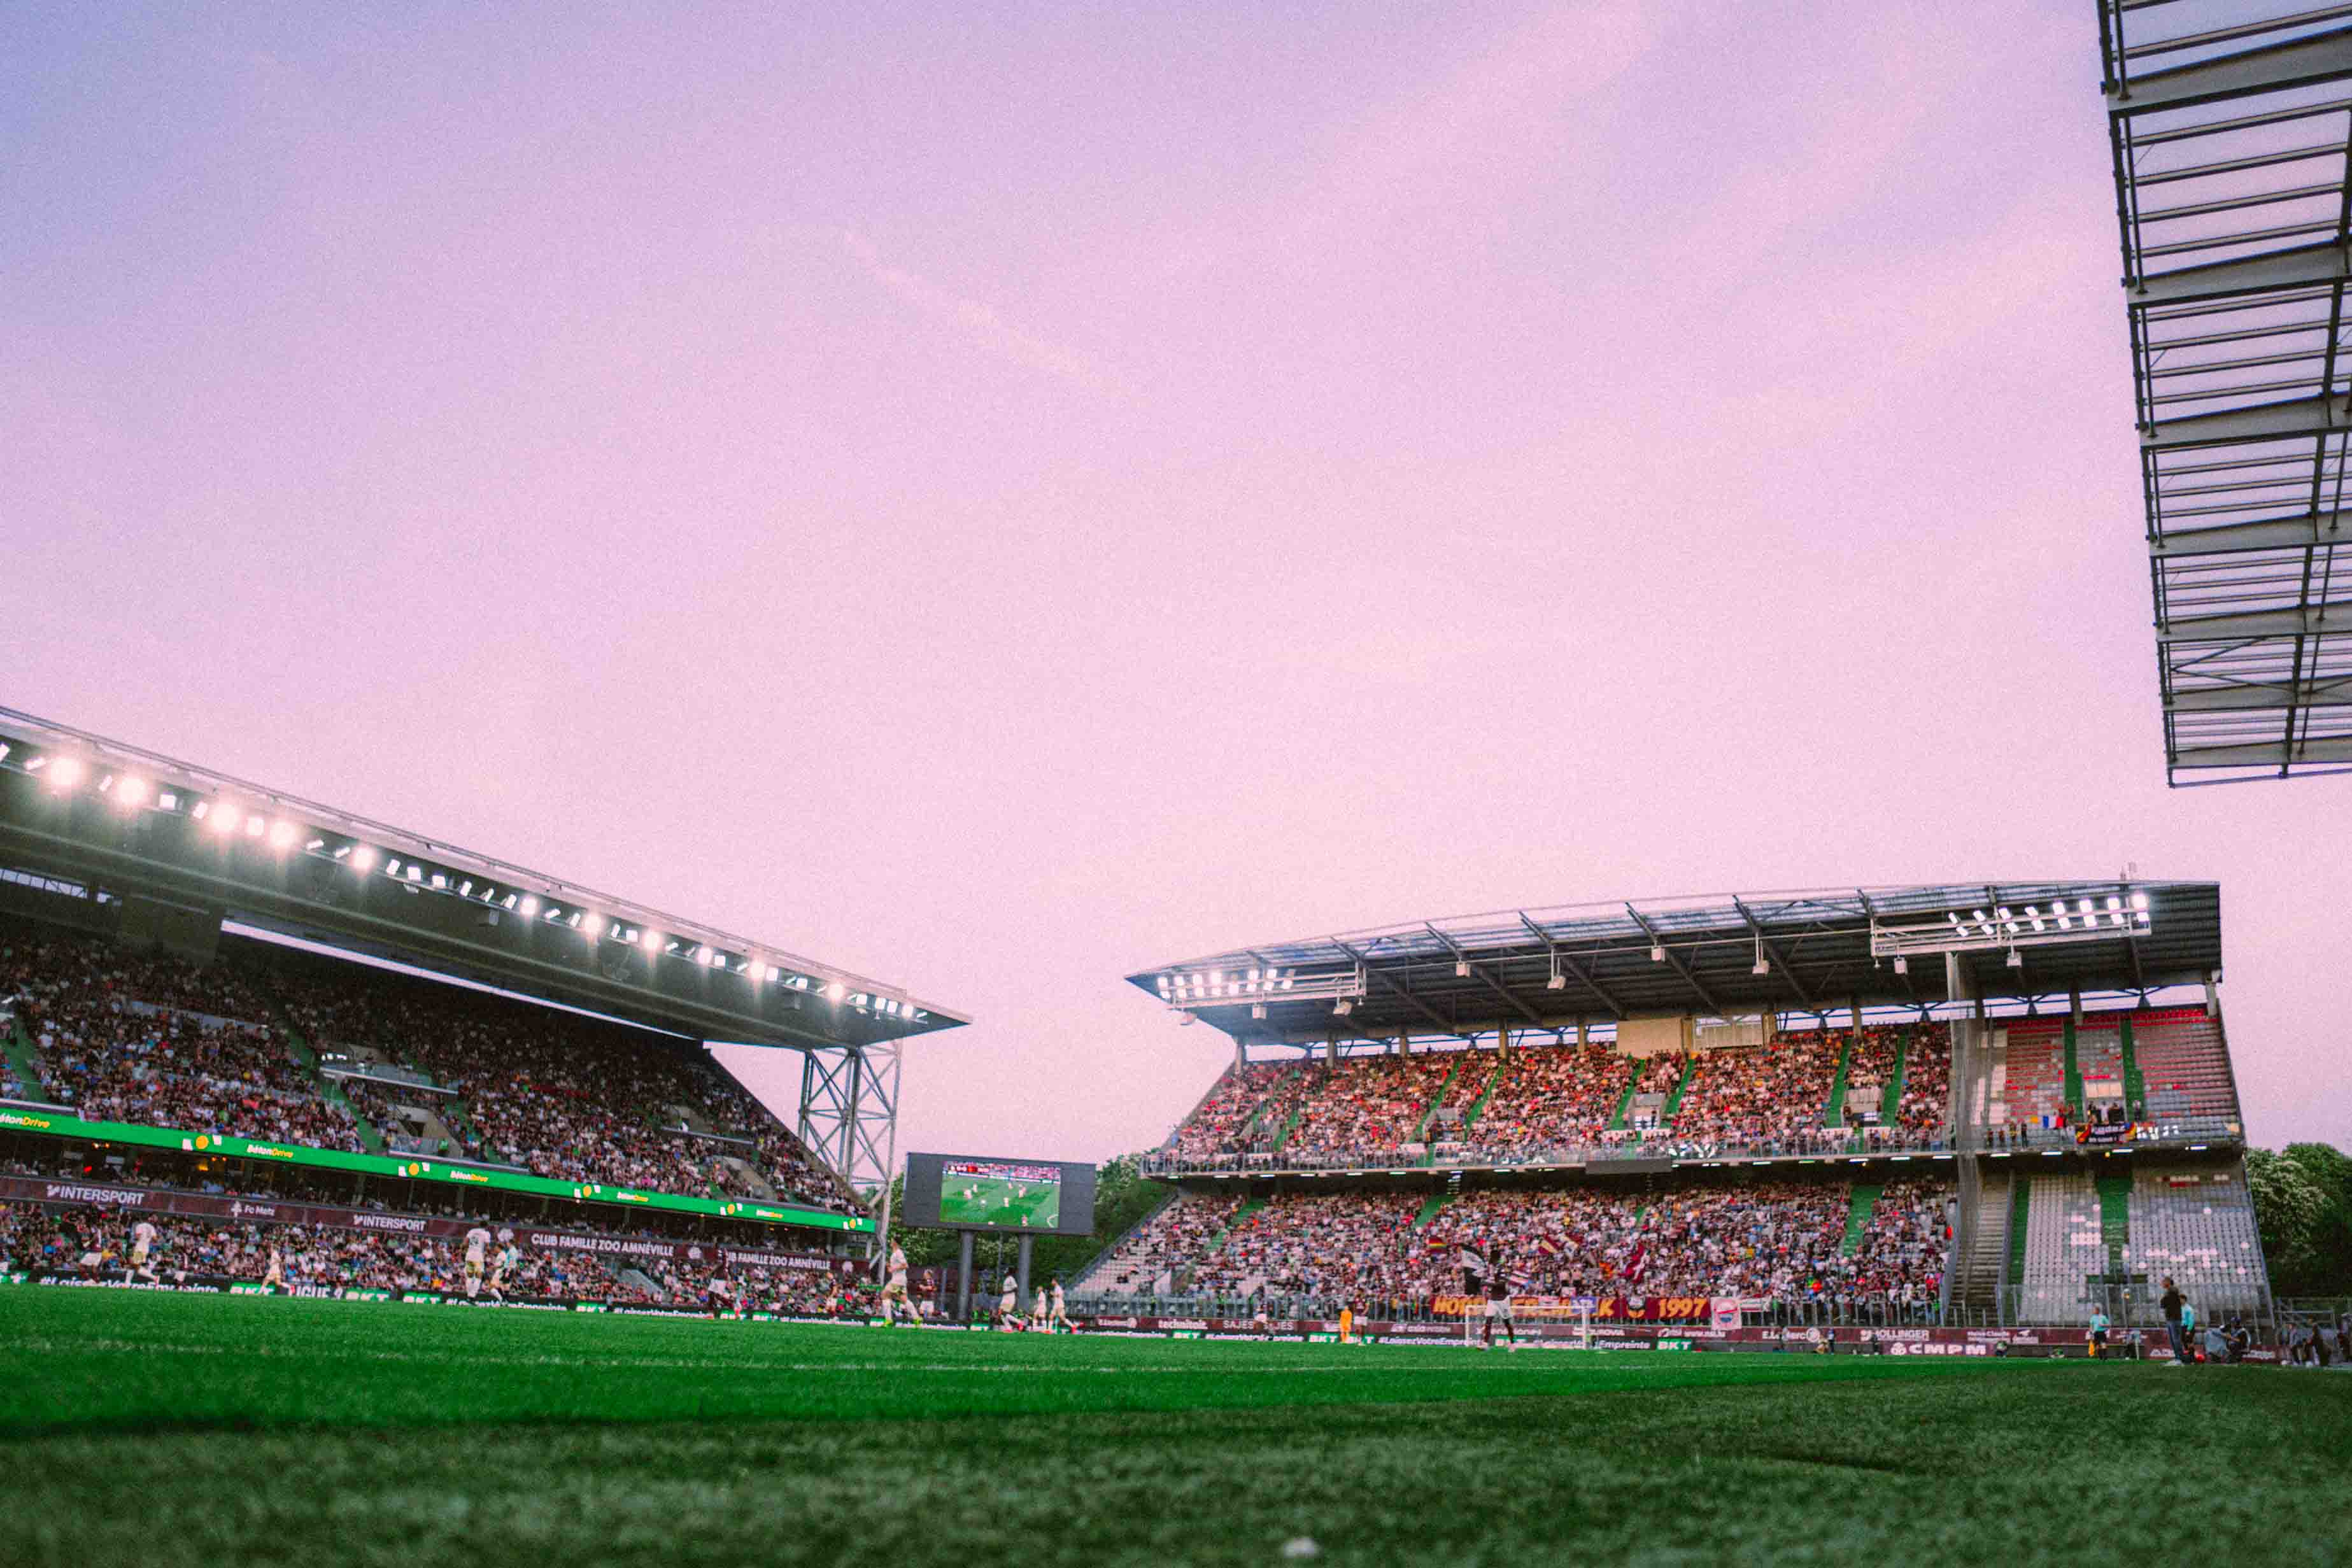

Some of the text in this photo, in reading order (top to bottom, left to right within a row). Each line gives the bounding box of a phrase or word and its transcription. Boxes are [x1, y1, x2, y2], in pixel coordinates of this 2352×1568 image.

[60, 1185, 145, 1205] INTERSPORT
[363, 1215, 427, 1231] INTERSPORT
[531, 1233, 674, 1257] CLUB FAMILLE ZOO AMNÉVILLE
[737, 1252, 768, 1265] FAMILLE
[769, 1256, 788, 1266] ZOO
[788, 1256, 830, 1270] AMNÉVILLE
[1659, 1297, 1708, 1318] 1997
[1223, 1320, 1253, 1330] SAJES
[1308, 1334, 1338, 1343] BKT
[1657, 1340, 1692, 1350] BKT
[1909, 1343, 1987, 1355] CMPM
